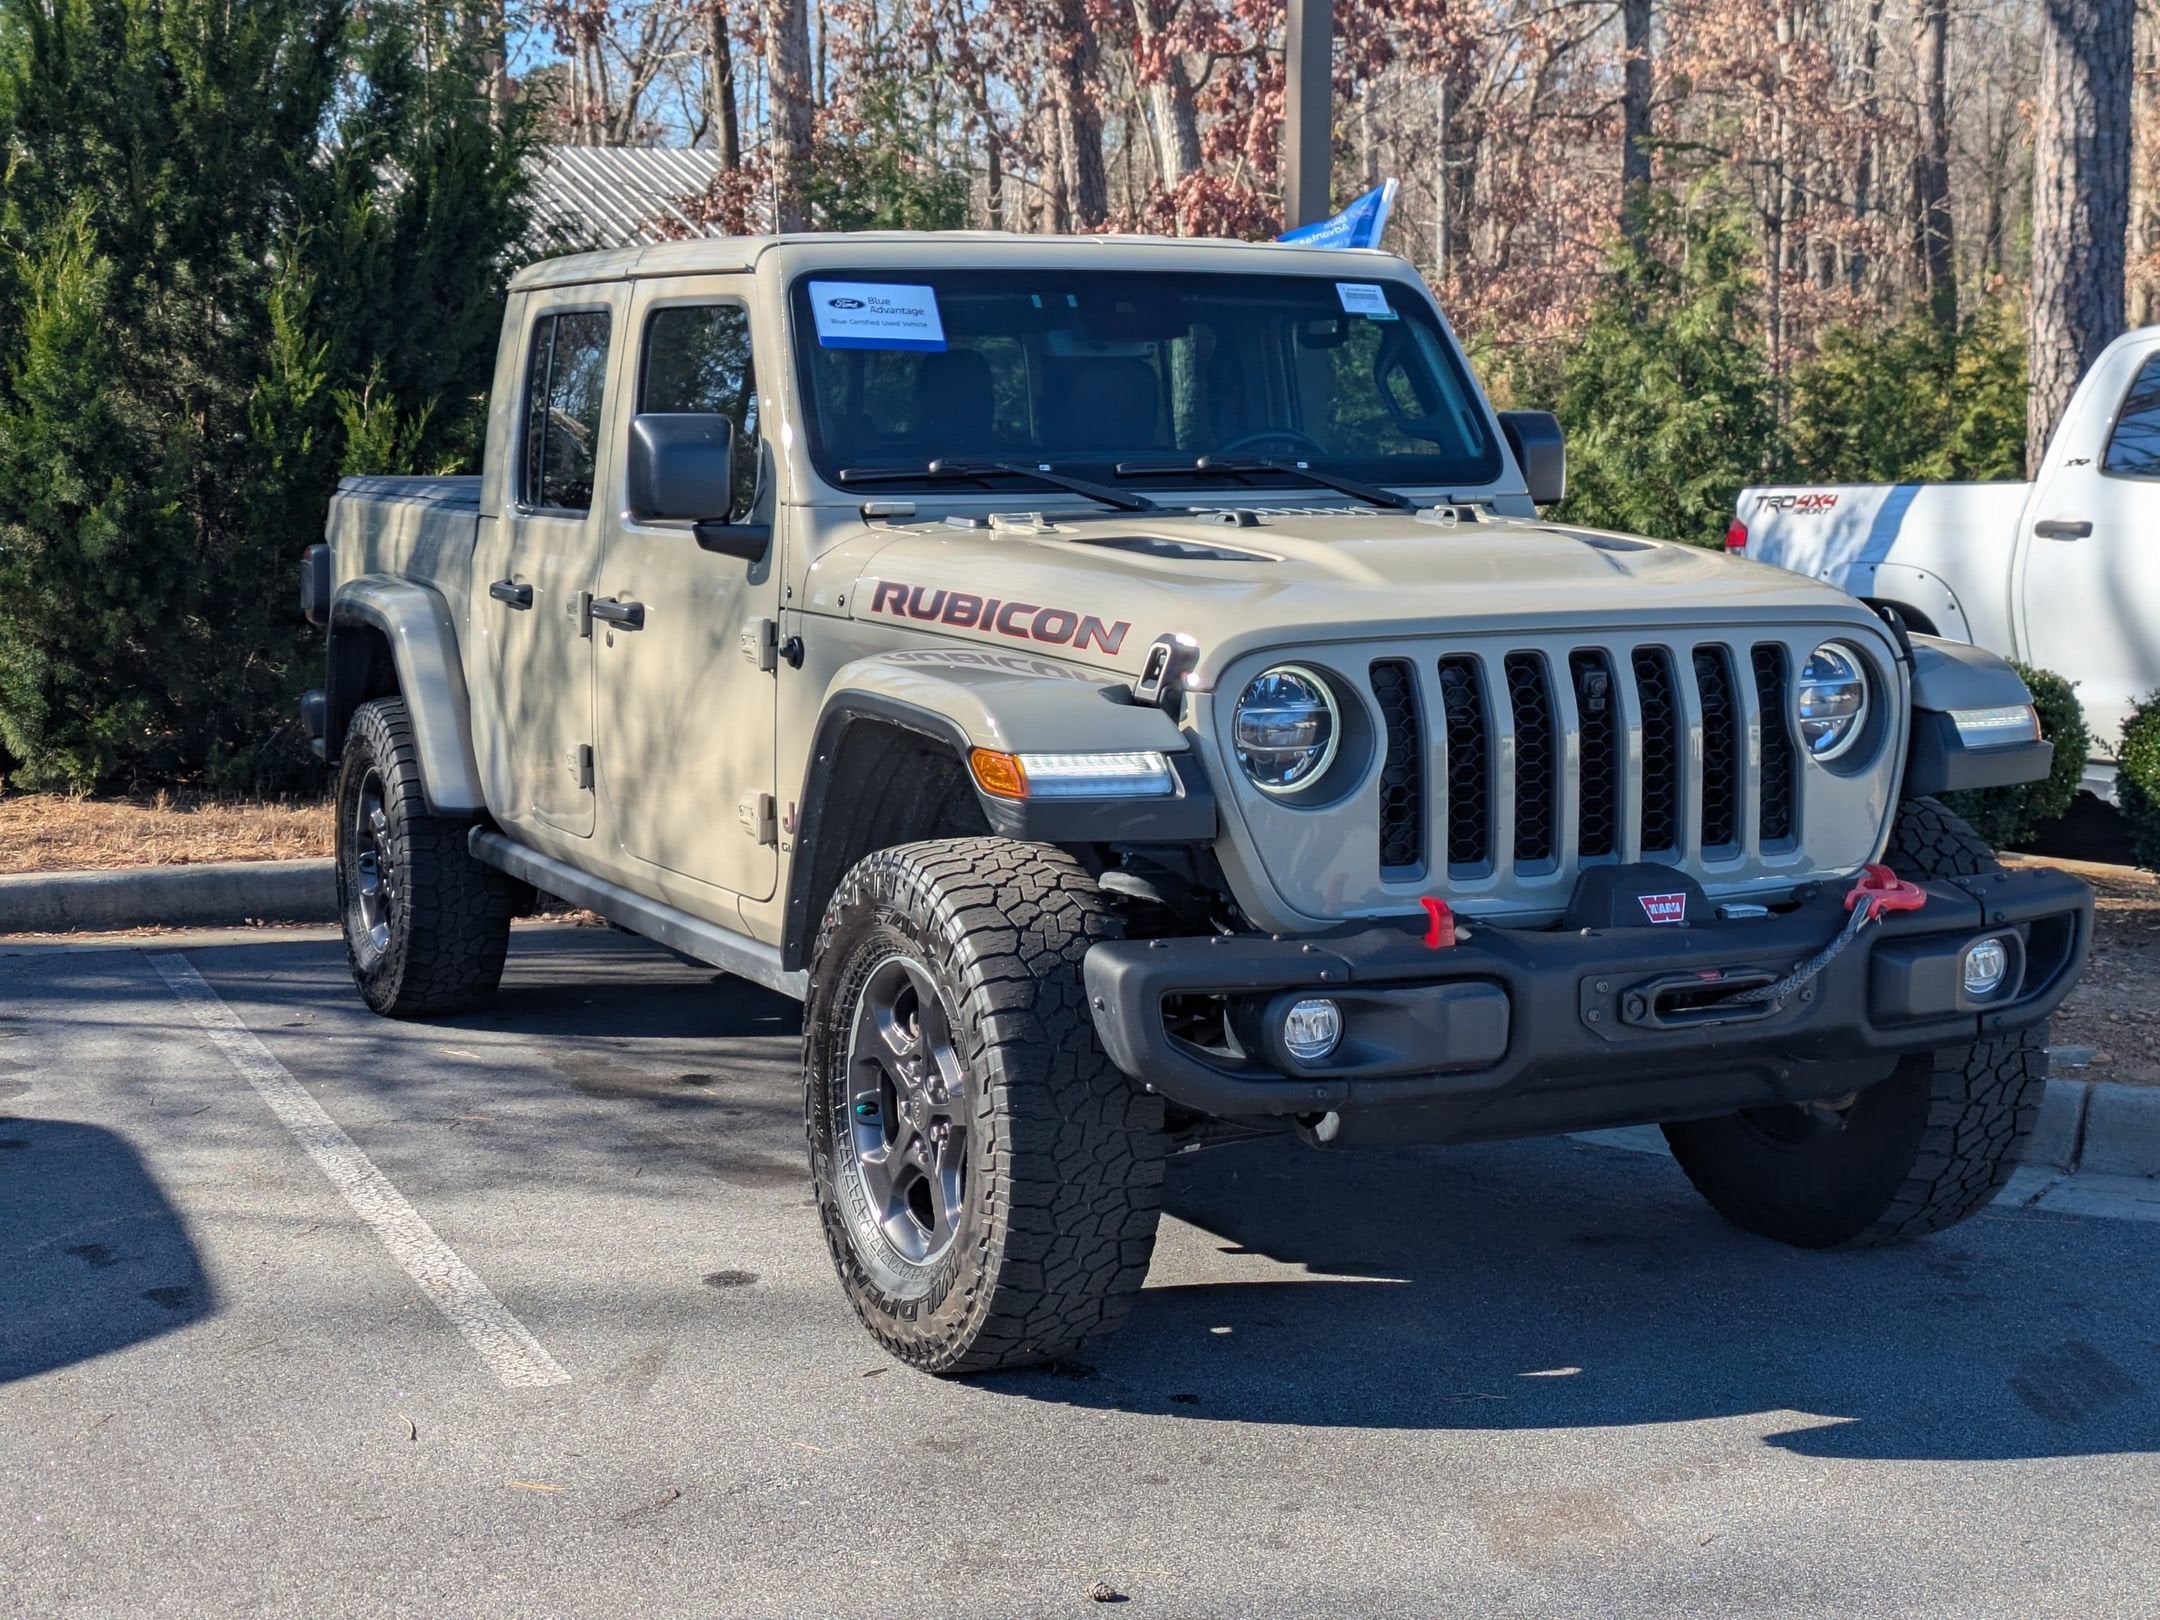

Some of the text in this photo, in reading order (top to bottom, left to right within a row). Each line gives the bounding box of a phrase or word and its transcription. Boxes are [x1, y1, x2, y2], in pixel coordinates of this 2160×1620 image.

[867, 297, 891, 305] Blue
[870, 306, 925, 316] Advantage
[1792, 507, 1832, 515] SPORT
[871, 580, 1132, 656] RUBICON
[1649, 902, 1681, 914] WARN
